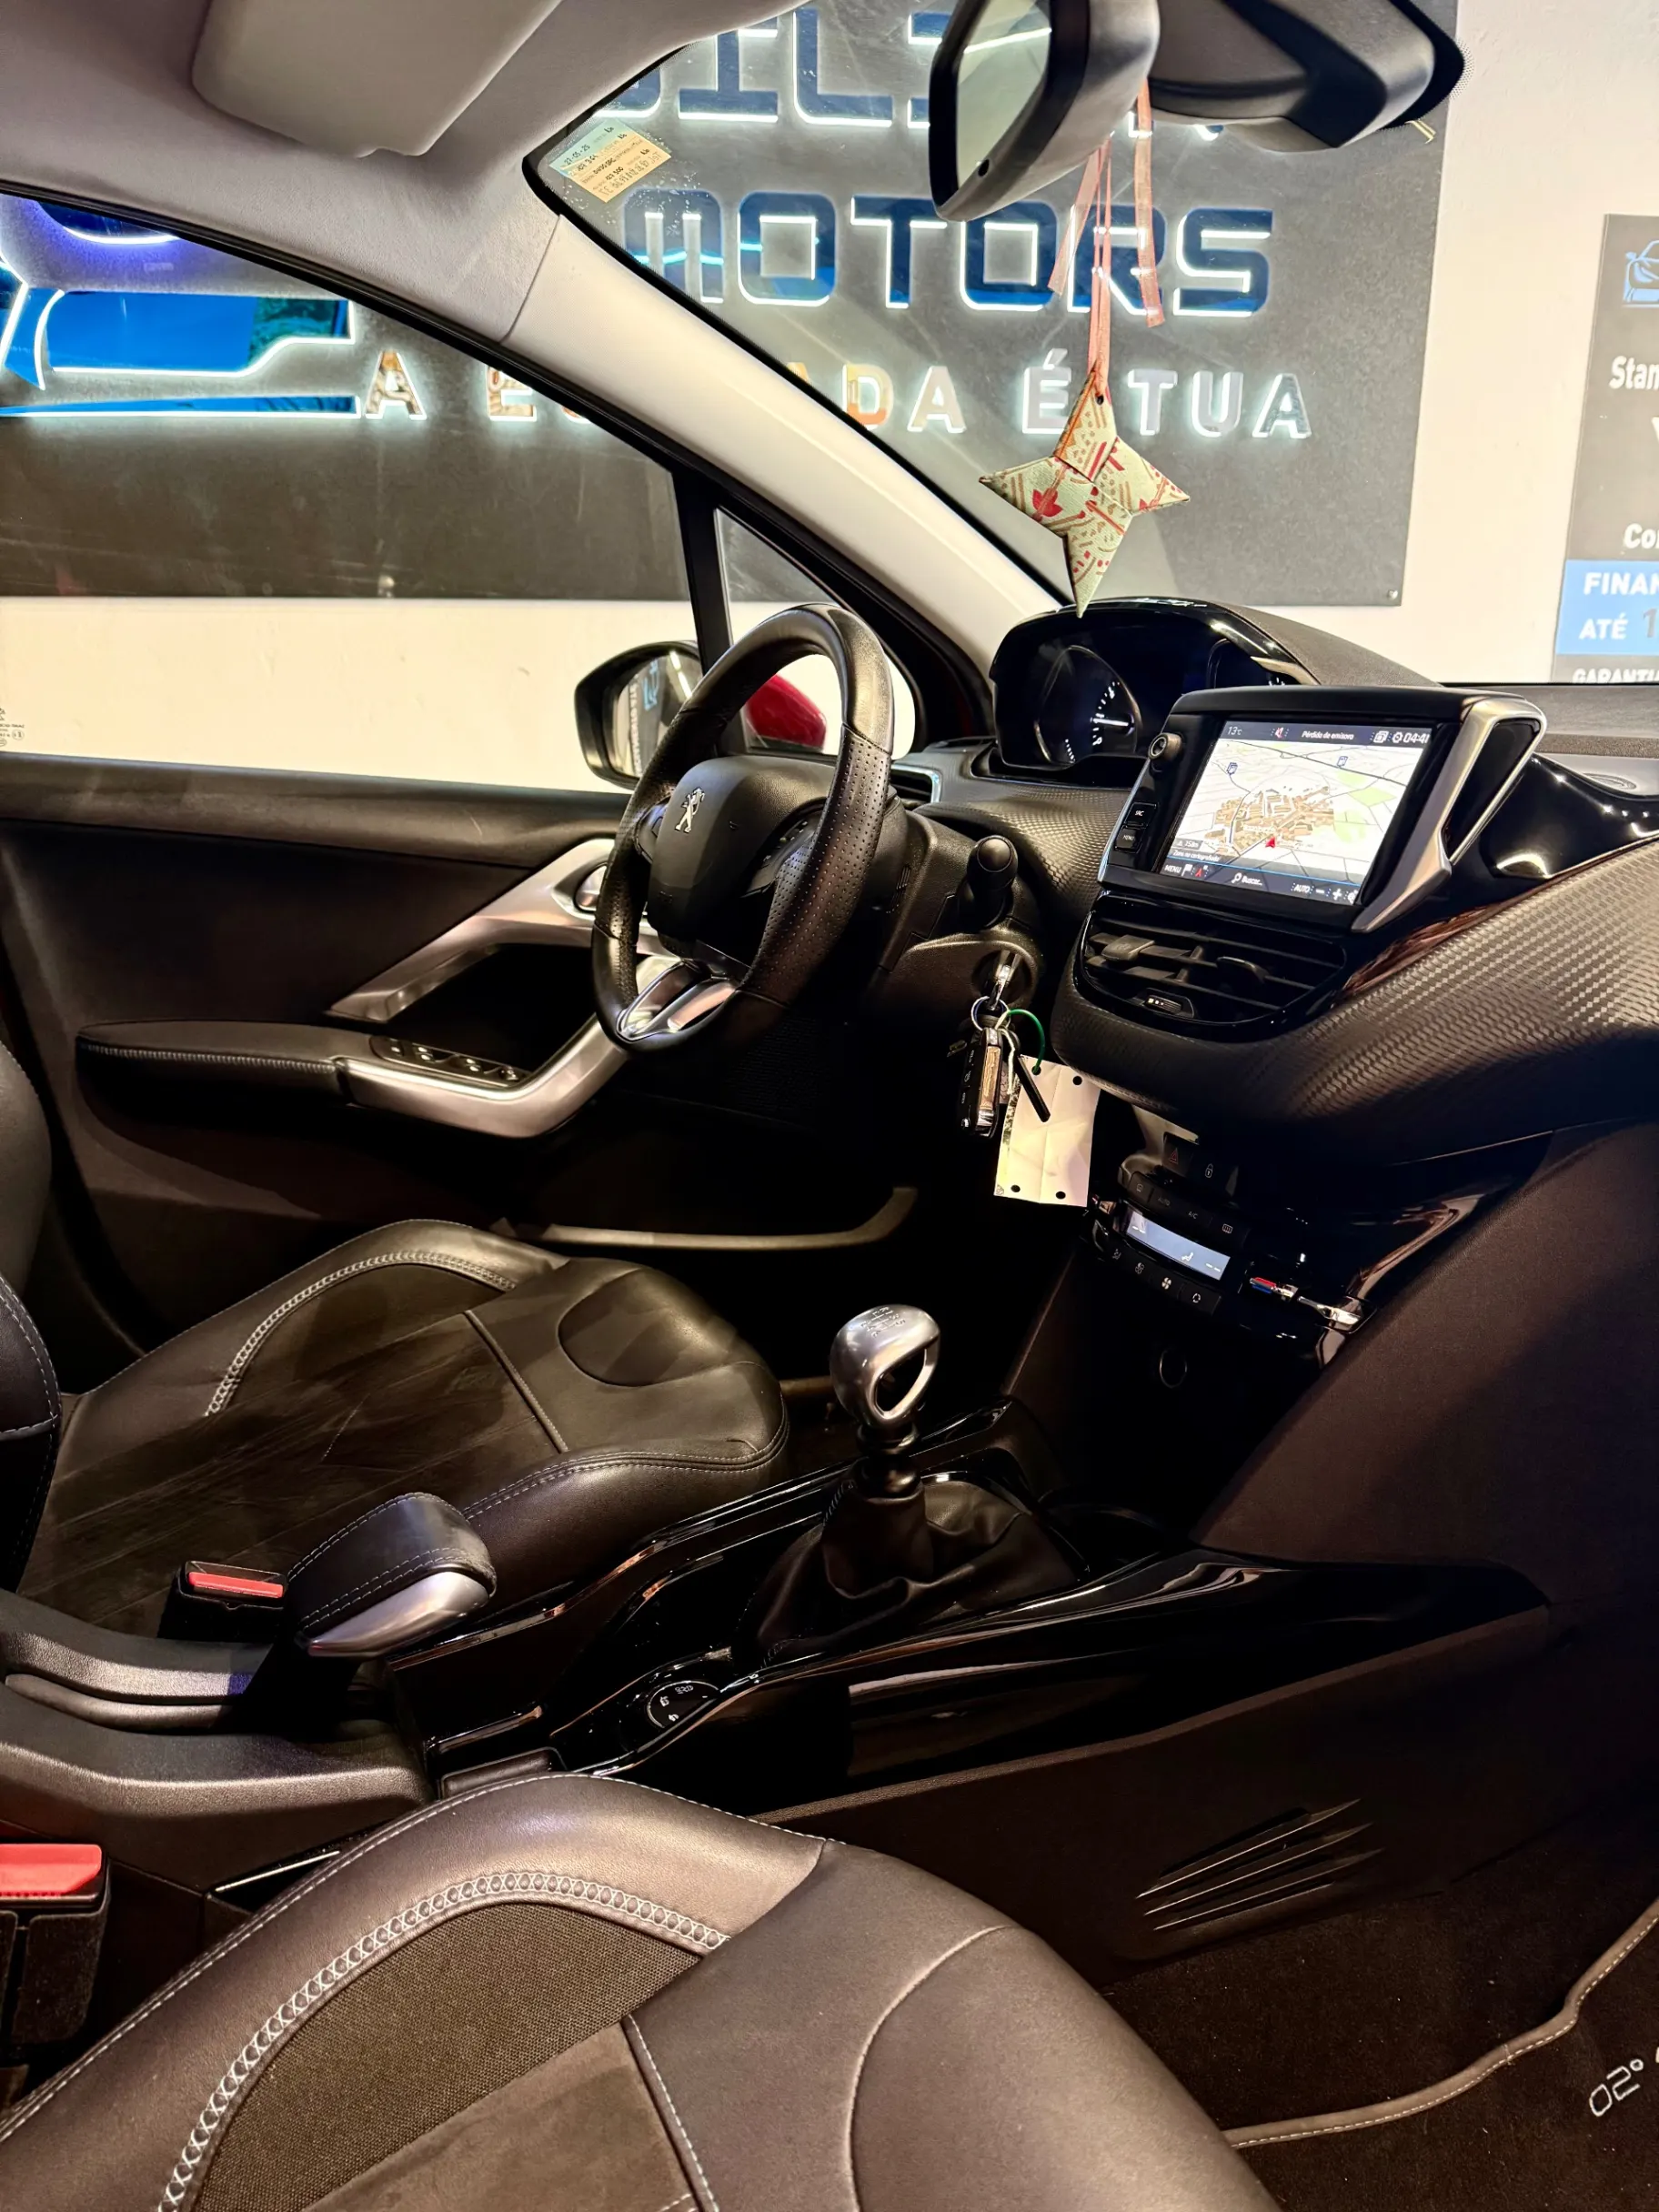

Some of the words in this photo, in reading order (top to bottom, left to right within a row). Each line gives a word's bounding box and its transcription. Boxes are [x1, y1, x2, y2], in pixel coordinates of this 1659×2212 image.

[622, 188, 1274, 317] MOTORS
[365, 350, 427, 420] A
[1021, 347, 1072, 435] É
[1126, 368, 1312, 439] TUA
[1624, 523, 1659, 549] Co
[1578, 612, 1629, 640] ATÉ
[1164, 864, 1182, 874] MENU
[1293, 883, 1311, 893] AUTO
